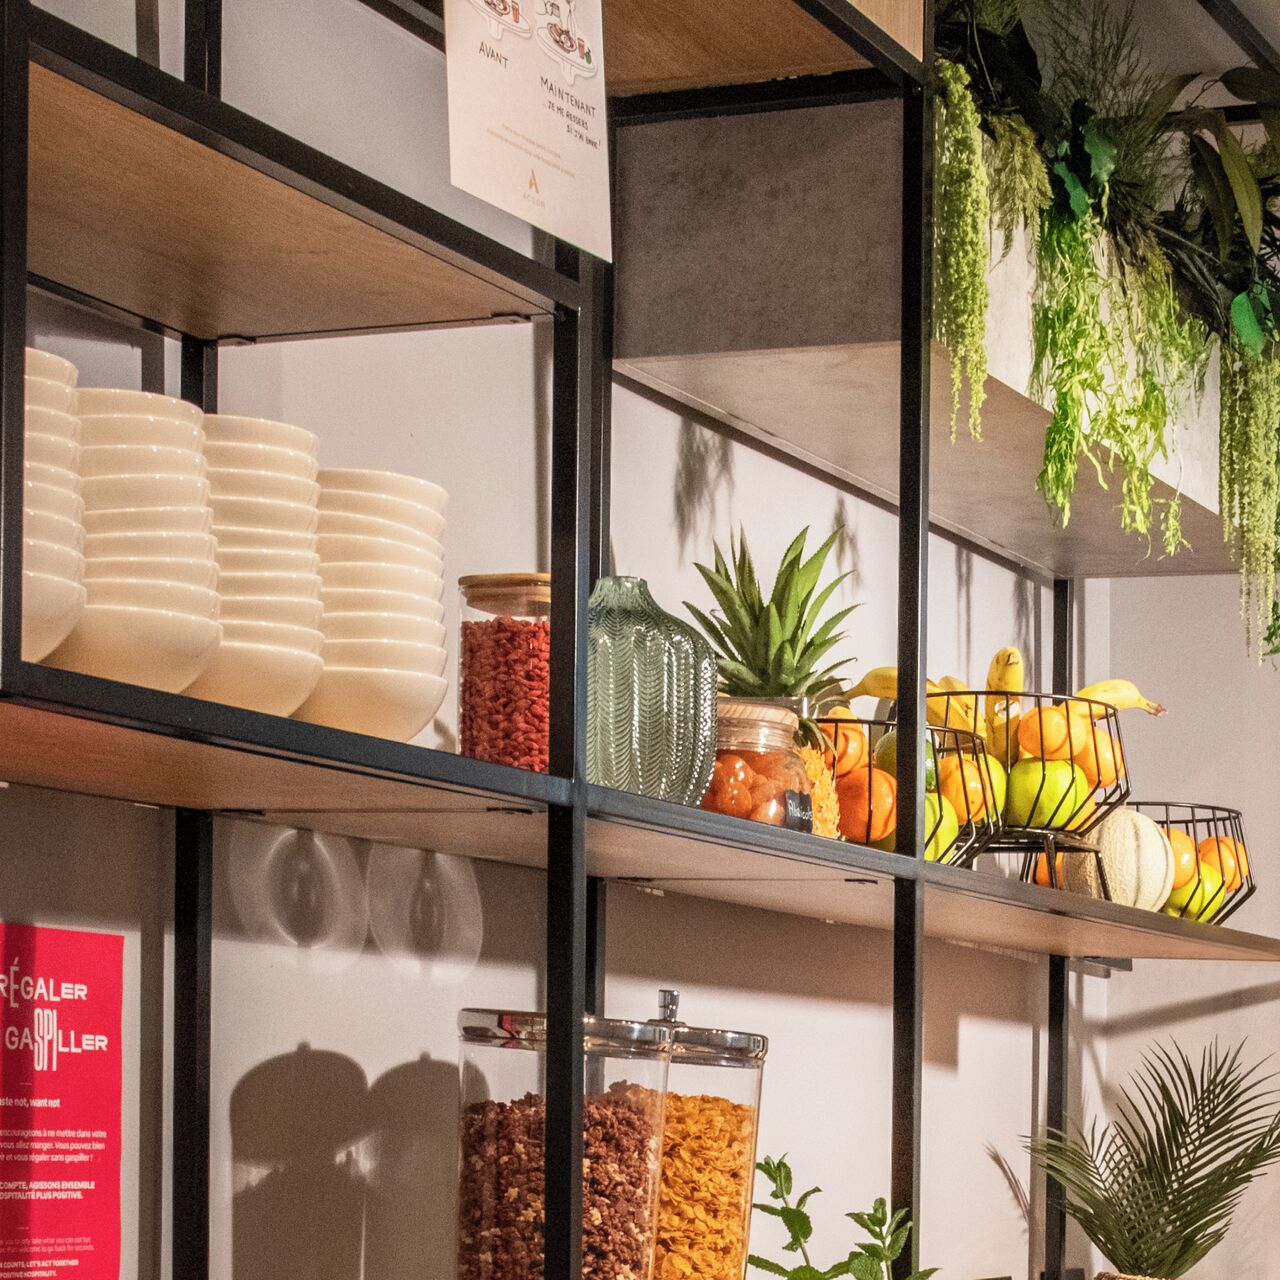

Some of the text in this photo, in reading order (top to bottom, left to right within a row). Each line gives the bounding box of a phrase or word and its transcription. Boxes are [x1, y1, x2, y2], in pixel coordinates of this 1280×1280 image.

[478, 41, 508, 69] AVANT
[540, 76, 596, 118] MAINTENANT
[5, 1008, 108, 1071] GASPILLER
[30, 1098, 47, 1107] want
[48, 1098, 60, 1108] not
[0, 1181, 28, 1190] COMPTE,
[28, 1181, 60, 1190] AGISSONS
[61, 1181, 96, 1189] ENSEMBLE
[36, 1191, 52, 1199] PLUS
[52, 1191, 84, 1199] POSITIVE.
